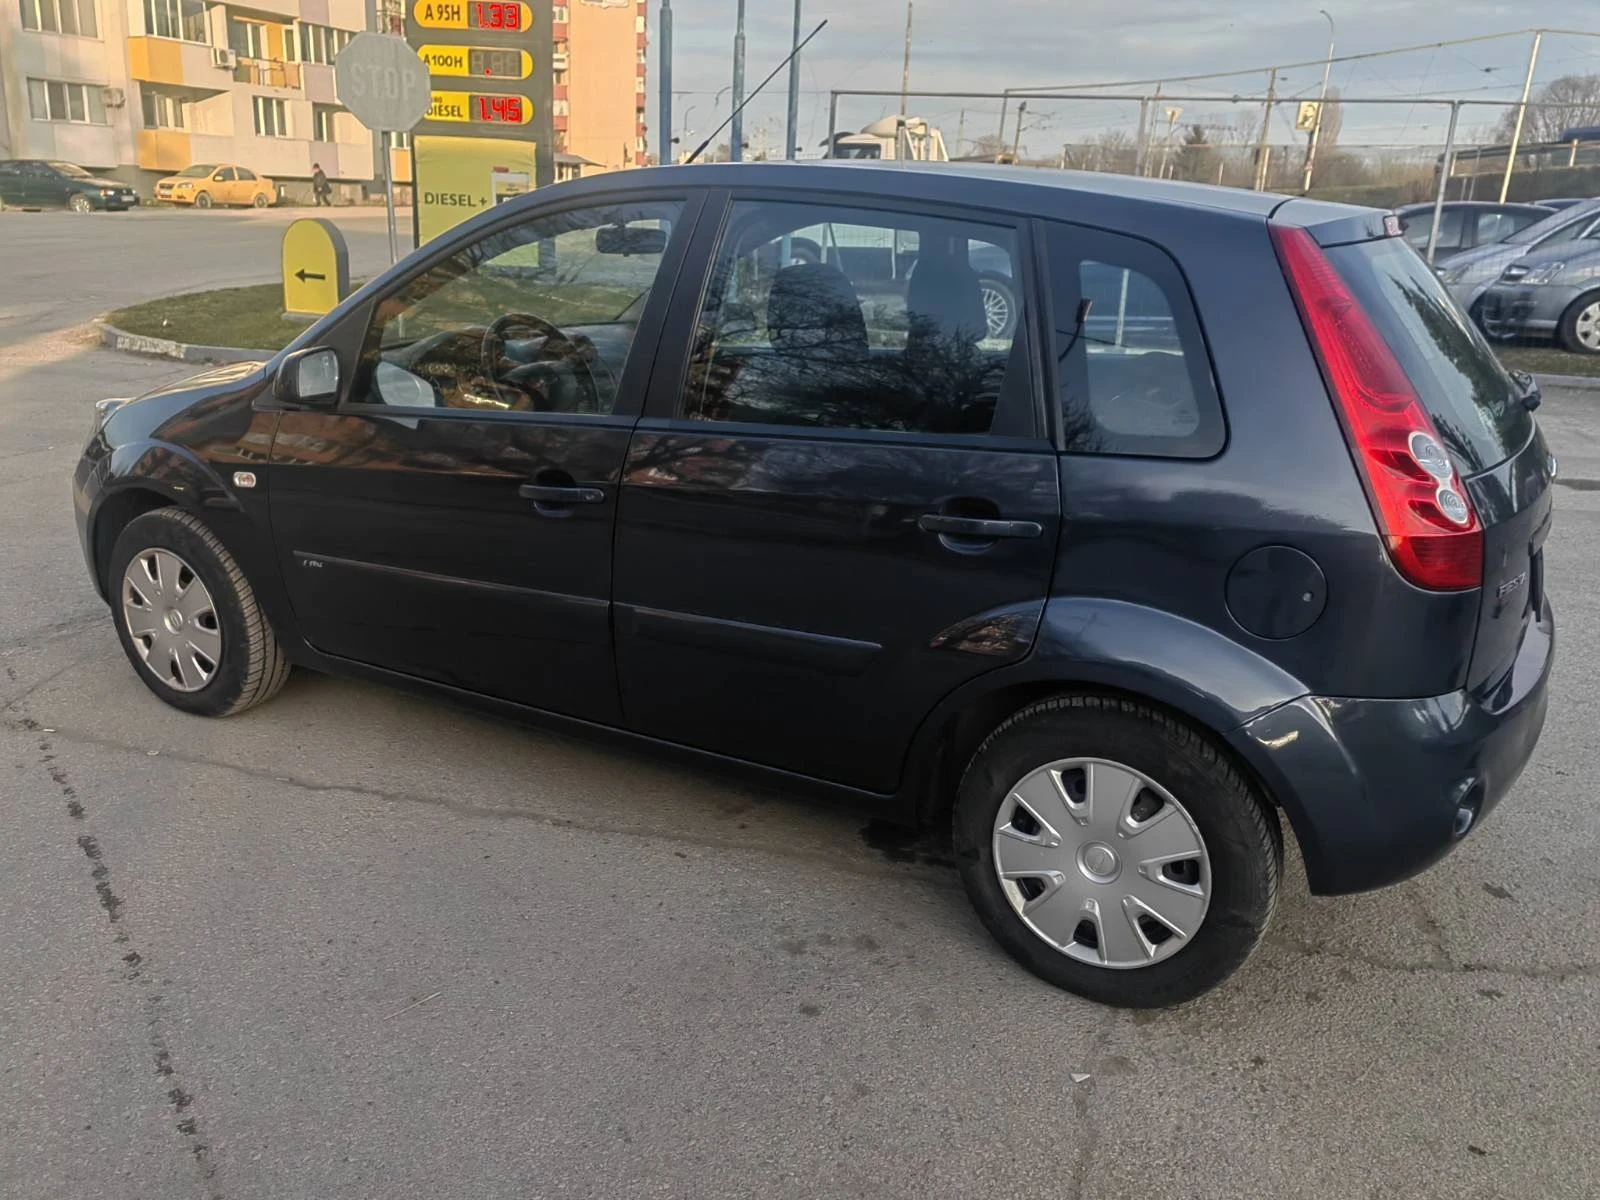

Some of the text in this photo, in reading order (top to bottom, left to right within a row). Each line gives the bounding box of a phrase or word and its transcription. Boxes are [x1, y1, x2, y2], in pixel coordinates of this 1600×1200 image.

[424, 3, 434, 21] A
[477, 2, 520, 30] 1.33
[350, 61, 416, 101] STOP
[479, 96, 522, 124] 1.45
[424, 191, 476, 207] DIESEL
